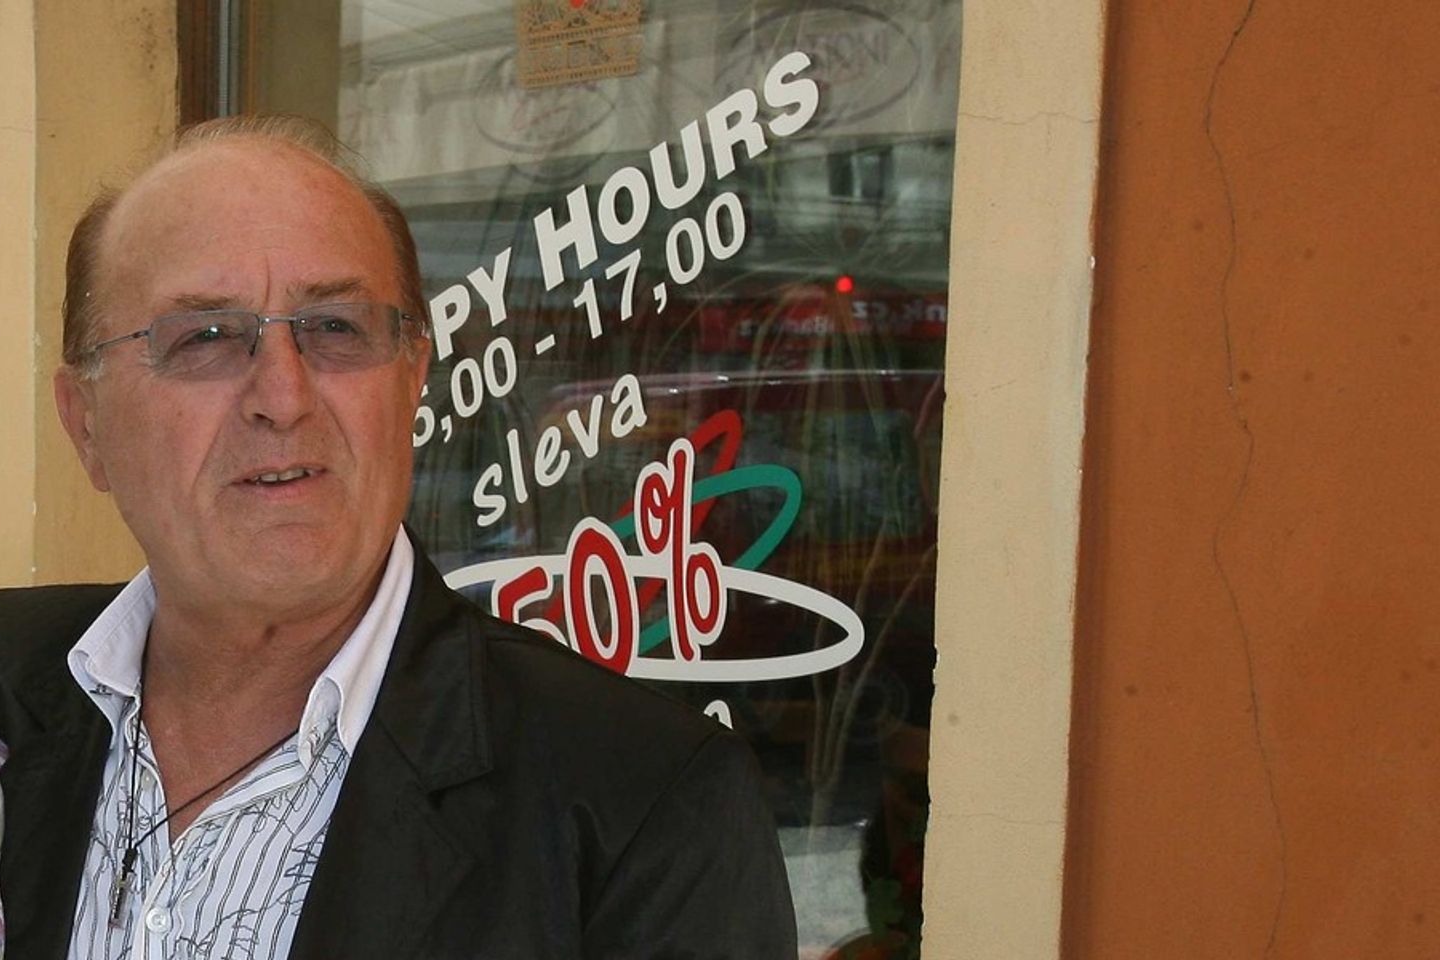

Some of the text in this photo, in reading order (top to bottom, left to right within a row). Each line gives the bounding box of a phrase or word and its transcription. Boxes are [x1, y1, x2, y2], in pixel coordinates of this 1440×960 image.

[533, 51, 819, 292] HOURS
[573, 192, 746, 339] 17,00
[472, 373, 648, 528] sleva
